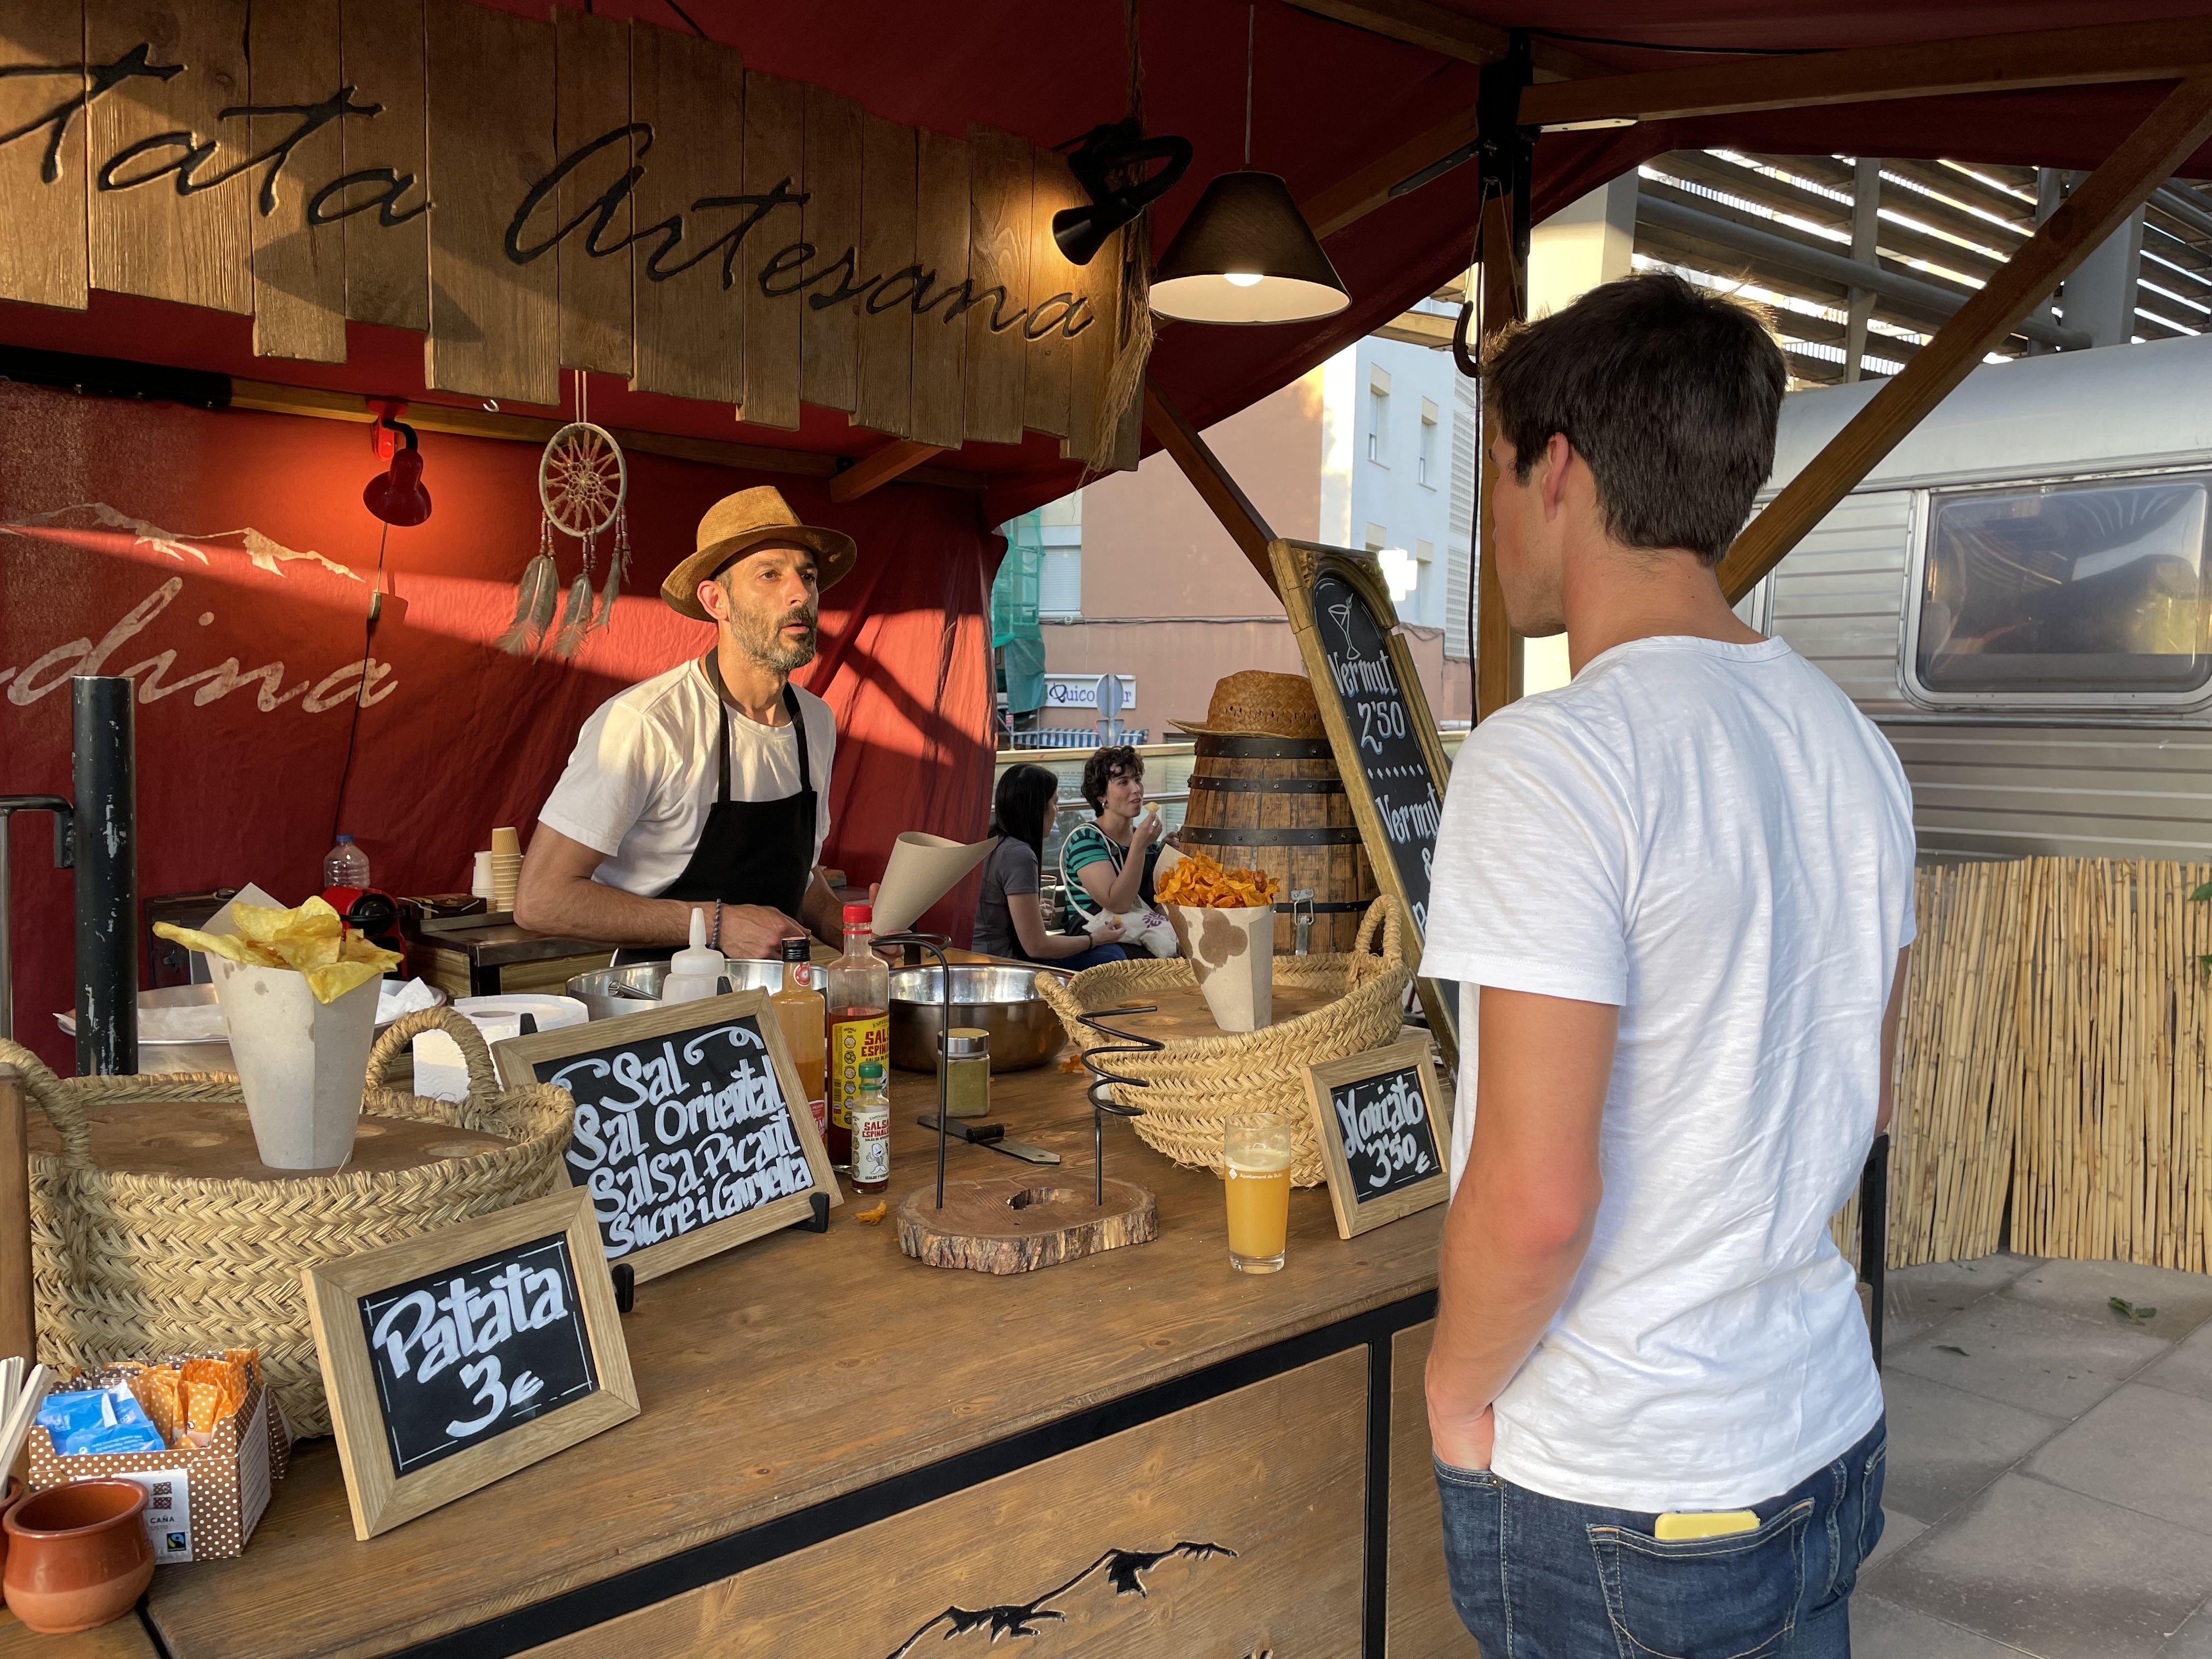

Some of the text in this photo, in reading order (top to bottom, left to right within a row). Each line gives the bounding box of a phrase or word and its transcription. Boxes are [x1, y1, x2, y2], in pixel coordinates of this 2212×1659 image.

[504, 122, 1096, 341] Artesana
[0, 577, 398, 713] dina
[1328, 649, 1398, 698] Vermut
[1049, 682, 1095, 703] Quico
[1358, 701, 1406, 755] 2'50
[1375, 782, 1442, 845] Vermut
[599, 1041, 690, 1113] Sal
[566, 1054, 786, 1170] Sal Oriental
[587, 1108, 801, 1223] Salsa Picant
[697, 1185, 714, 1224] i
[373, 1263, 568, 1384] Patata
[150, 1515, 175, 1524] CAÑA
